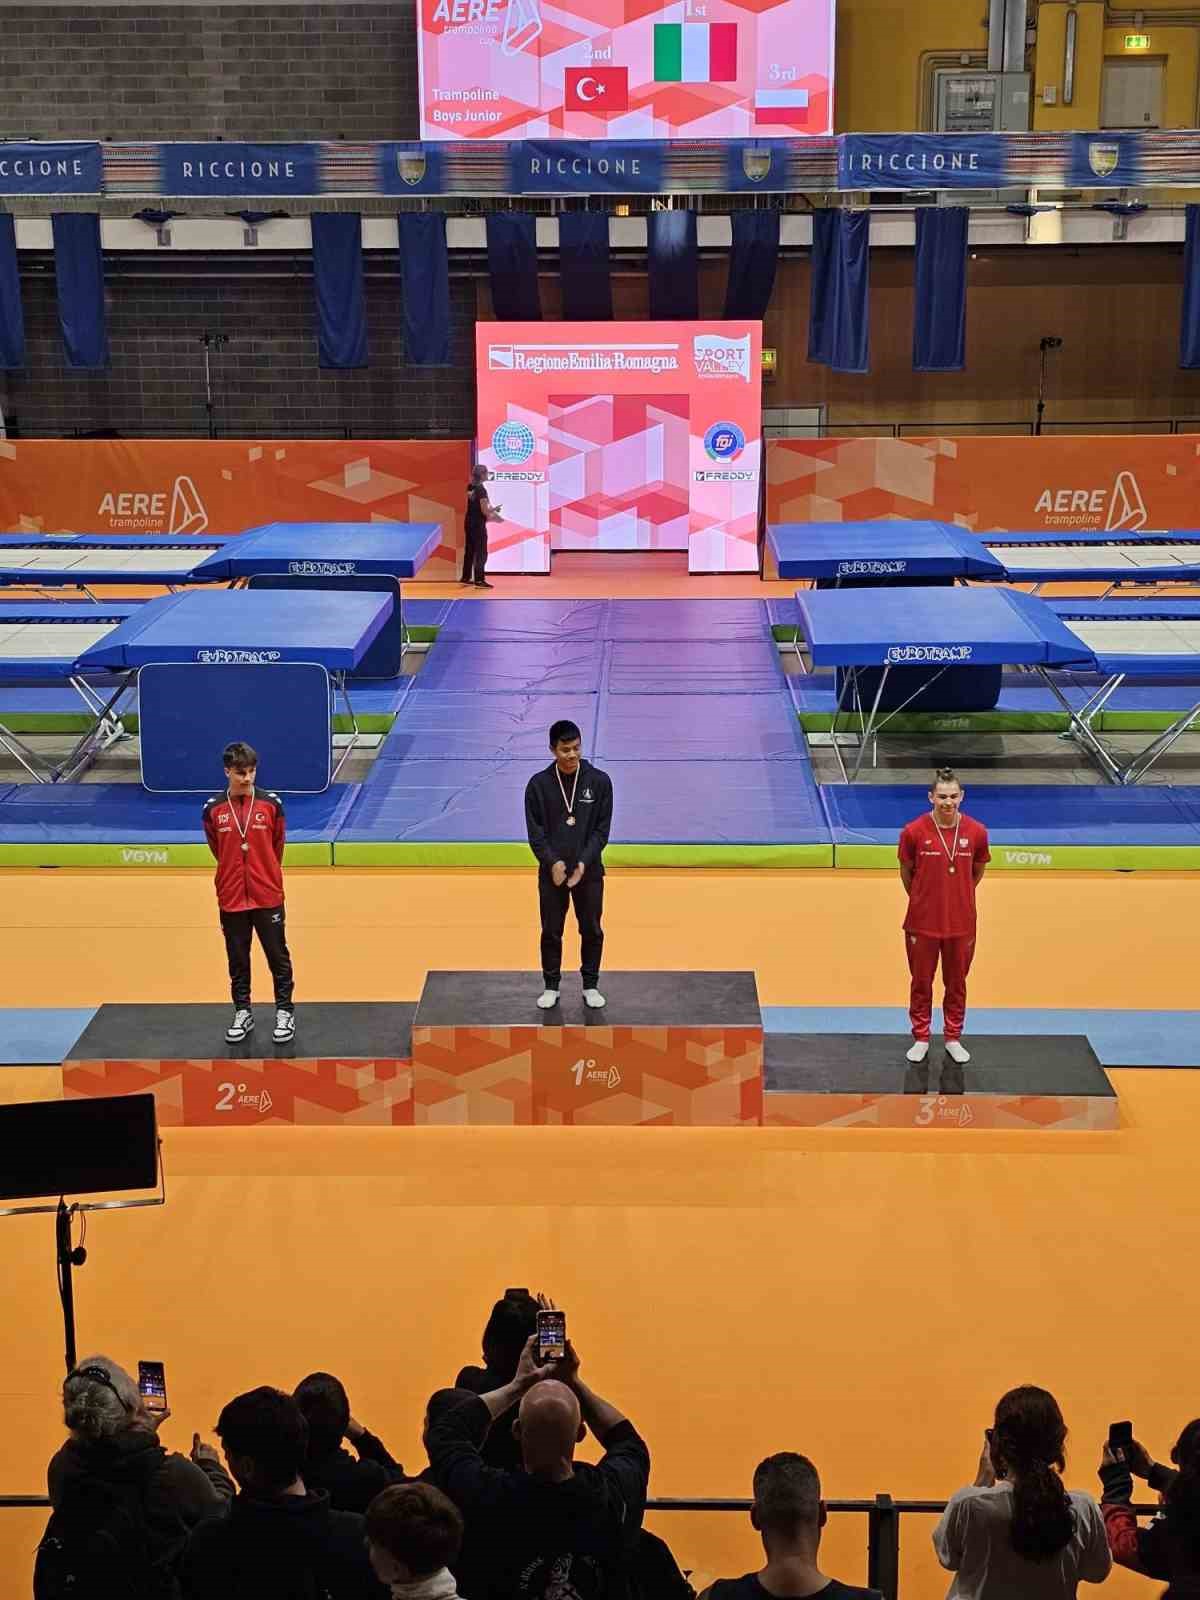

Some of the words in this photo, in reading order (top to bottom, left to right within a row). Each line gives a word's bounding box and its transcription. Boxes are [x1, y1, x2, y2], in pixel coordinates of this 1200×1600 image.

[432, 0, 499, 22] AERE
[583, 44, 612, 60] 2nd
[769, 64, 797, 81] 3rd
[432, 88, 499, 102] Trampoline
[433, 110, 462, 124] Boys
[465, 110, 502, 121] Junior
[530, 159, 640, 175] RICCIONE
[862, 153, 979, 170] RICCIONE
[183, 161, 295, 178] RICCIONE
[695, 348, 745, 360] SPORT
[694, 360, 745, 372] VALLEY
[496, 472, 543, 481] FREDDY
[706, 472, 753, 480] FREDDY
[98, 493, 167, 515] AERE
[1034, 490, 1107, 513] AERE
[110, 517, 163, 528] trampoline
[1045, 514, 1101, 527] trampoline
[289, 561, 355, 575] EUROTRAMP
[838, 561, 906, 575] EUROTRAMP
[197, 649, 281, 664] EUROTRAMP
[888, 646, 973, 662] EUROTRAMP
[122, 849, 168, 864] VGYM
[1004, 851, 1053, 865] VGYM
